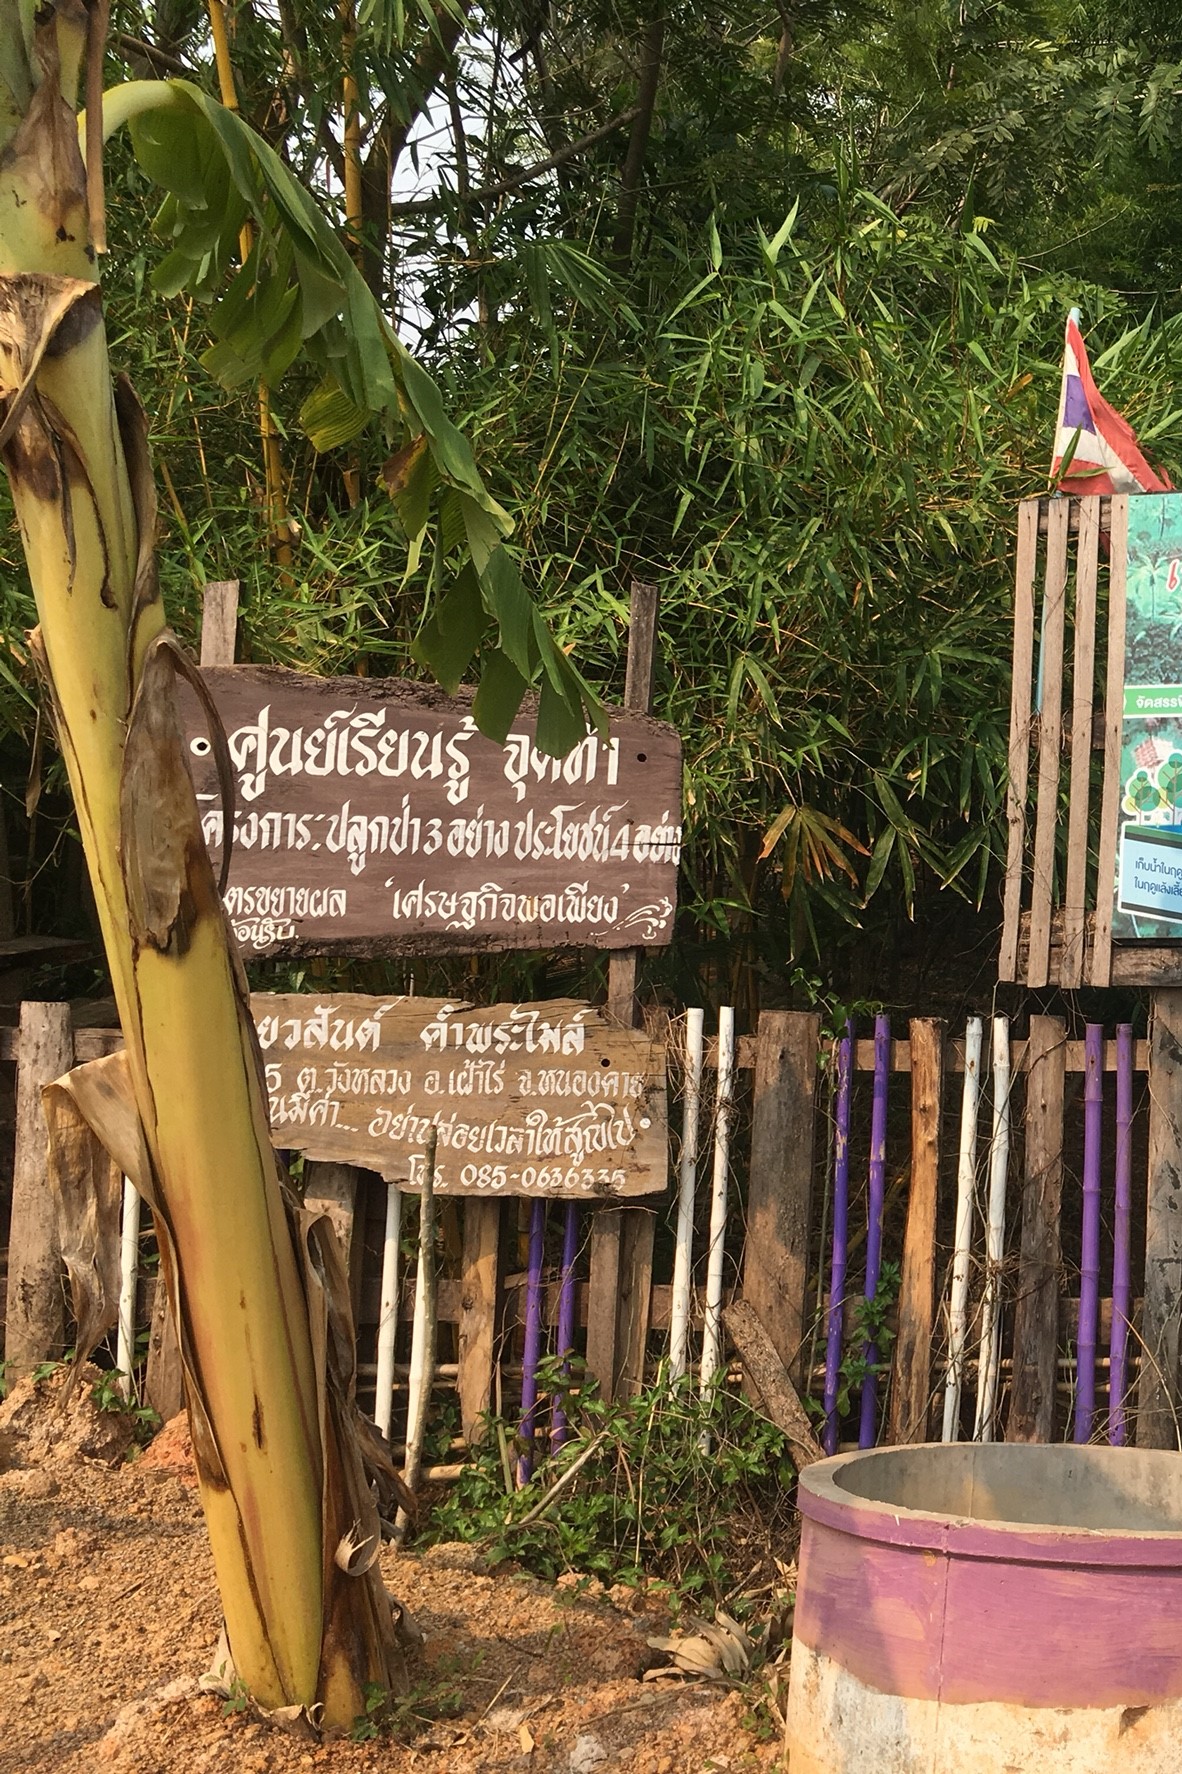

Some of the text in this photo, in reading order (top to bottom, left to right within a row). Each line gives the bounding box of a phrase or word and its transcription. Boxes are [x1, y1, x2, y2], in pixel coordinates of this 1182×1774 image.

[227, 703, 479, 806] ศูนย์เรียนรู้
[253, 995, 406, 1053] ยวสันต์
